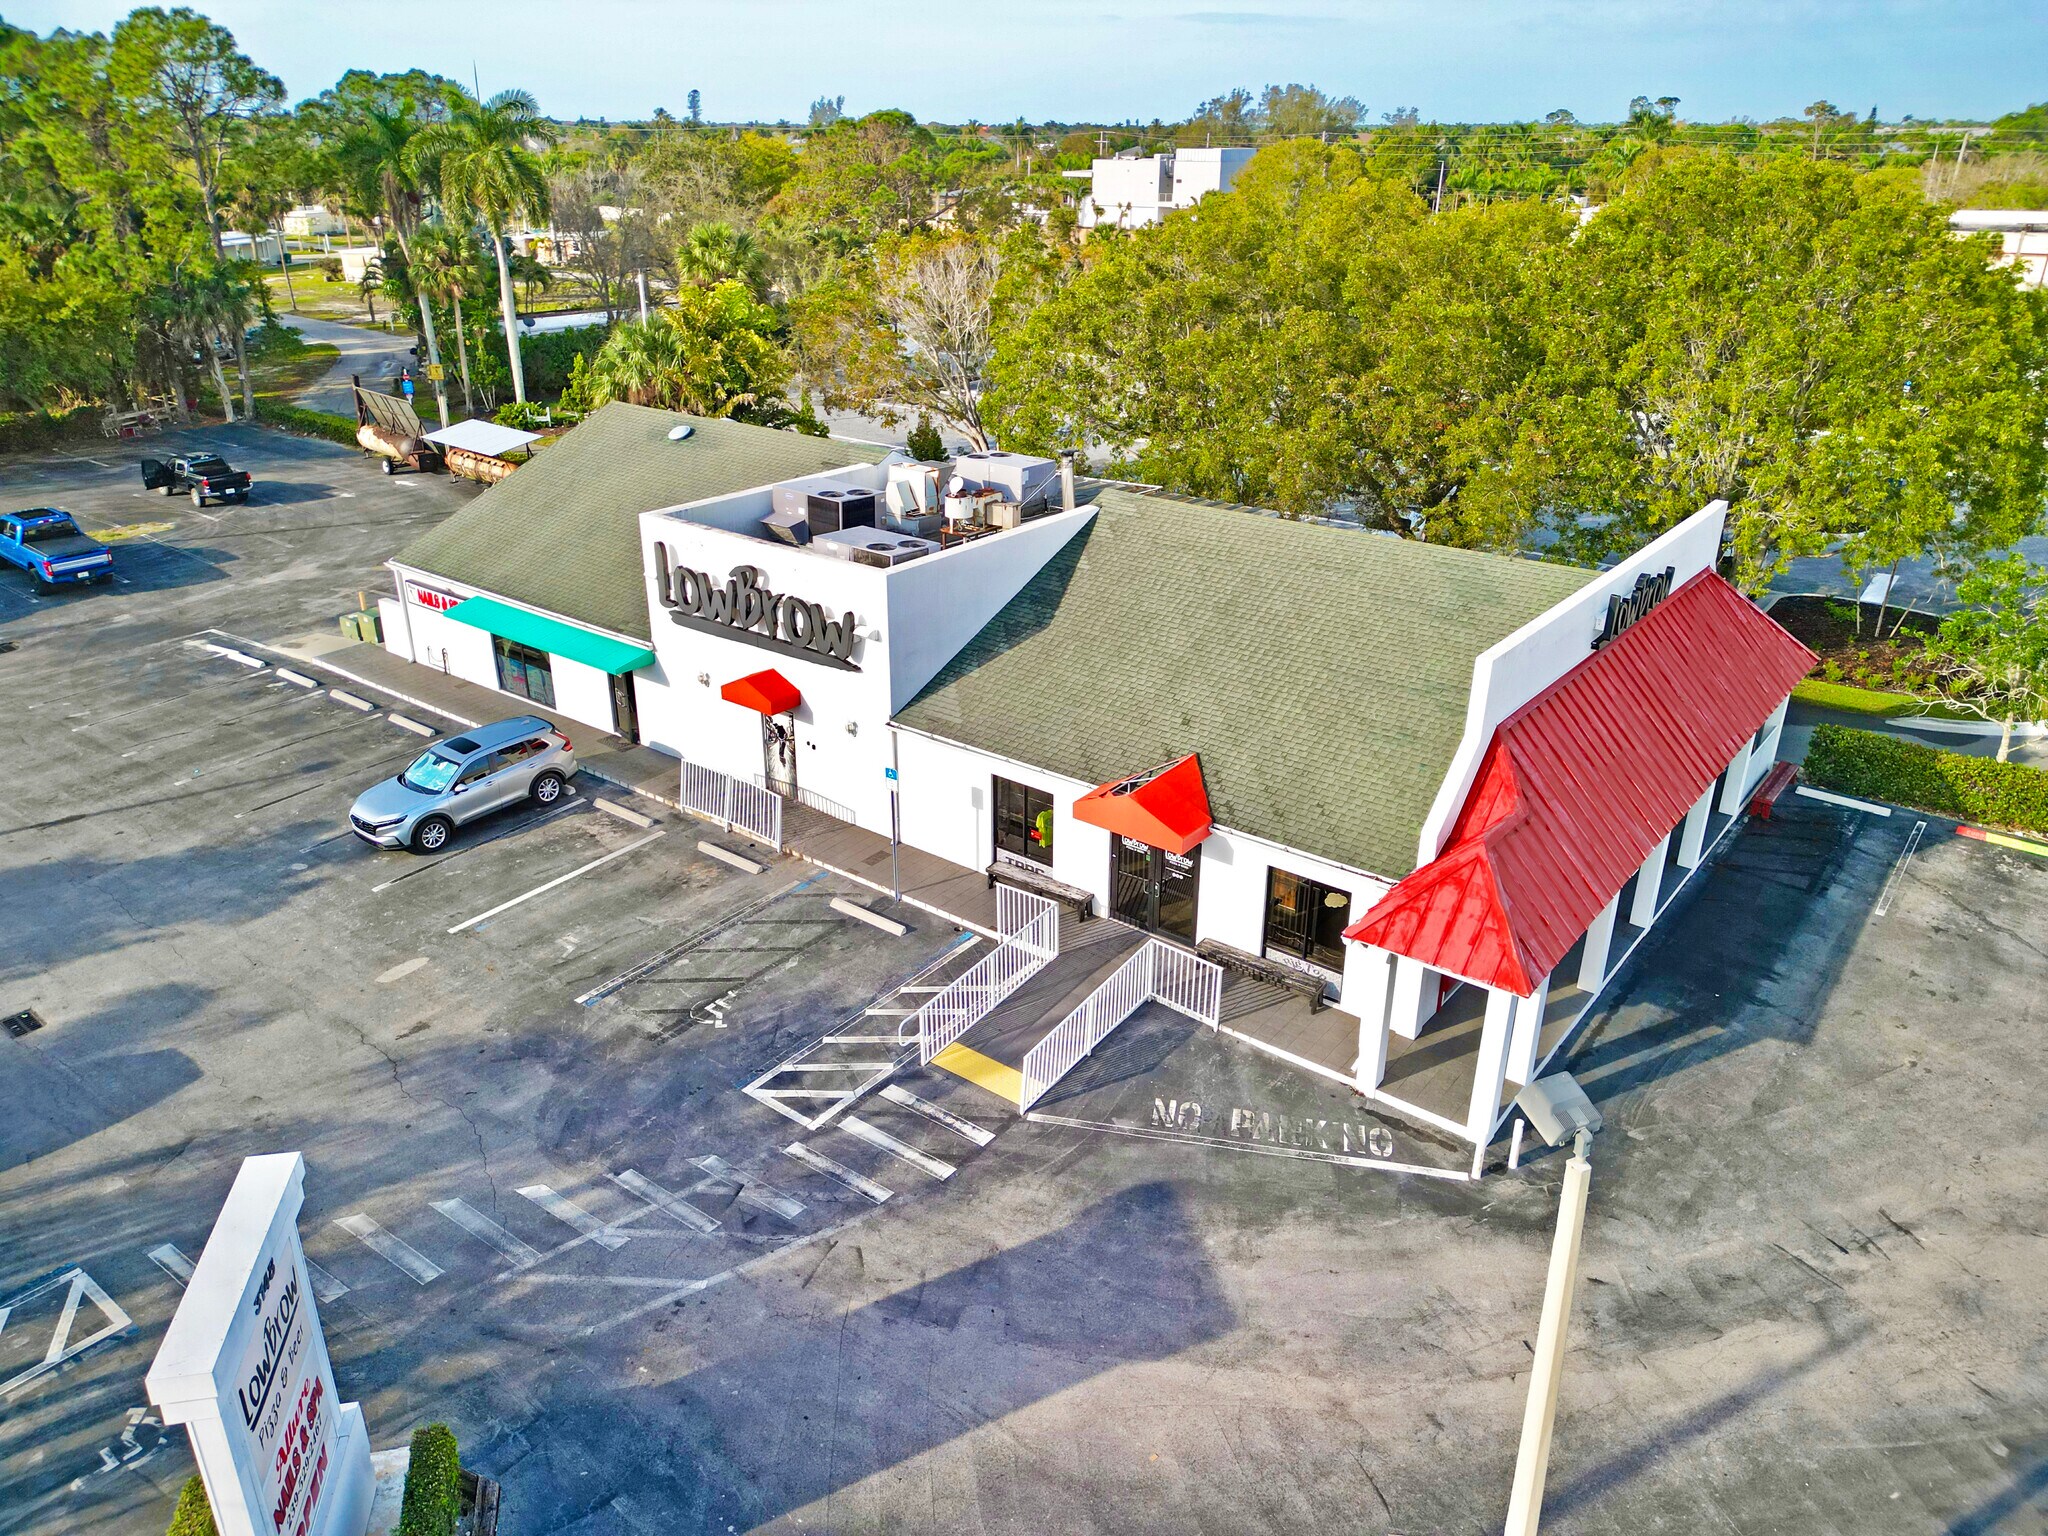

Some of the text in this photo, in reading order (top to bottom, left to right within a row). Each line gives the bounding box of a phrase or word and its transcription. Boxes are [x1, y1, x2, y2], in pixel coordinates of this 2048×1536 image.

[417, 589, 440, 609] NAILS
[1151, 1098, 1202, 1130] NO
[258, 1391, 282, 1451] Pizza
[276, 1377, 311, 1485] Allure
[273, 1446, 302, 1535] NAILS
